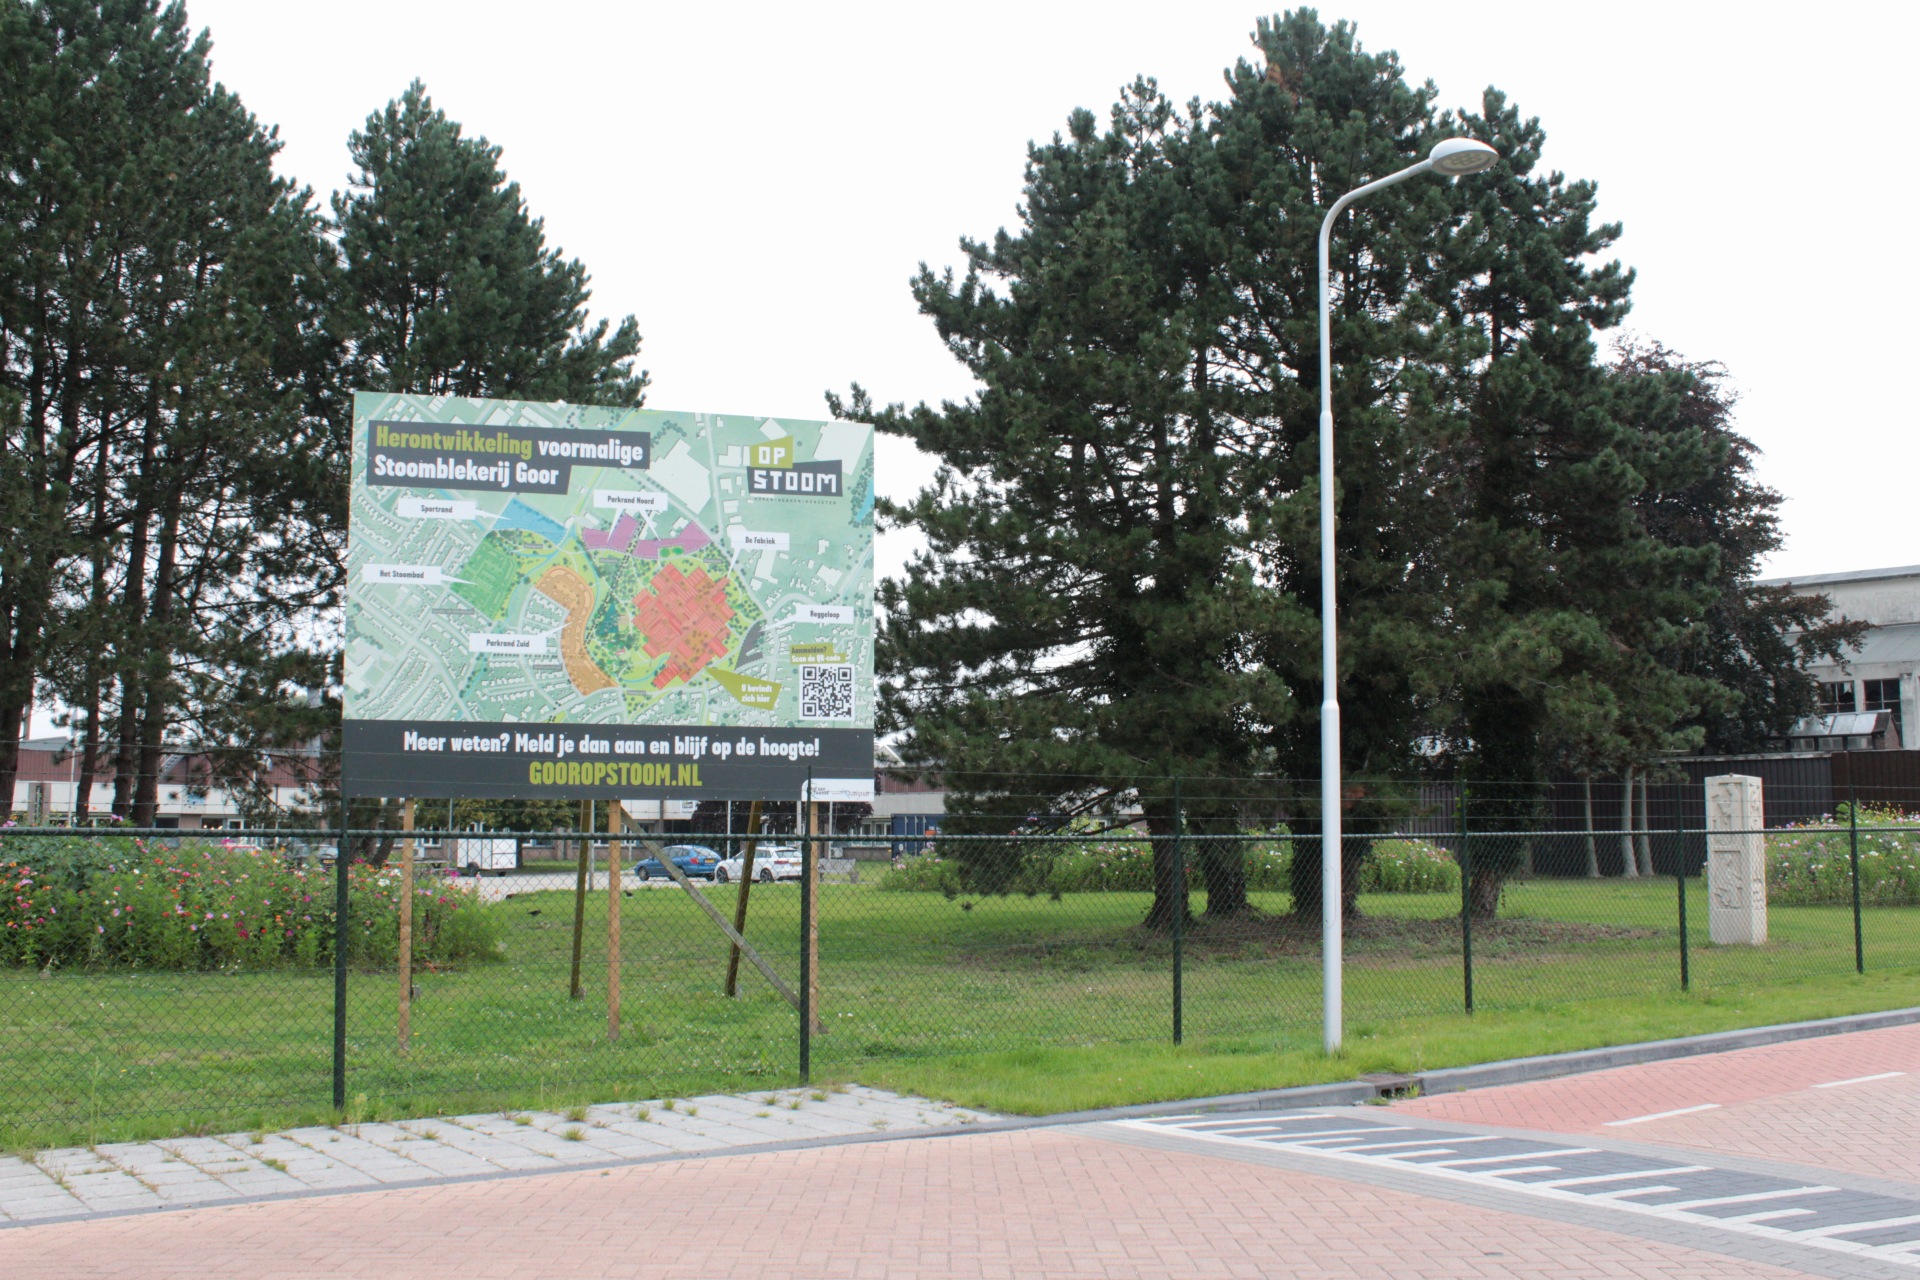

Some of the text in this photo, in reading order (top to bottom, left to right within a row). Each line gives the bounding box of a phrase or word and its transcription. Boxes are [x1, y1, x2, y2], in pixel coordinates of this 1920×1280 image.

[376, 425, 644, 466] Herontwikkeling voormalige
[758, 446, 786, 465] OP
[374, 454, 560, 488] Stoomblekerij Goor
[753, 470, 838, 493] STOOM
[607, 495, 655, 505] Parkrand Noord
[421, 504, 453, 514] Sportrand
[745, 536, 776, 545] De Fabriek
[380, 570, 425, 580] Het Stoombad
[486, 639, 530, 648] Parkrand Zuid
[792, 655, 807, 663] Scan
[741, 684, 772, 693] U bevindt
[741, 693, 771, 703] zich hier
[404, 731, 820, 761] Meer weten? Meld je dan aan en blijf op de hoogte!
[529, 761, 702, 787] GOOROPSTOOM.NL
